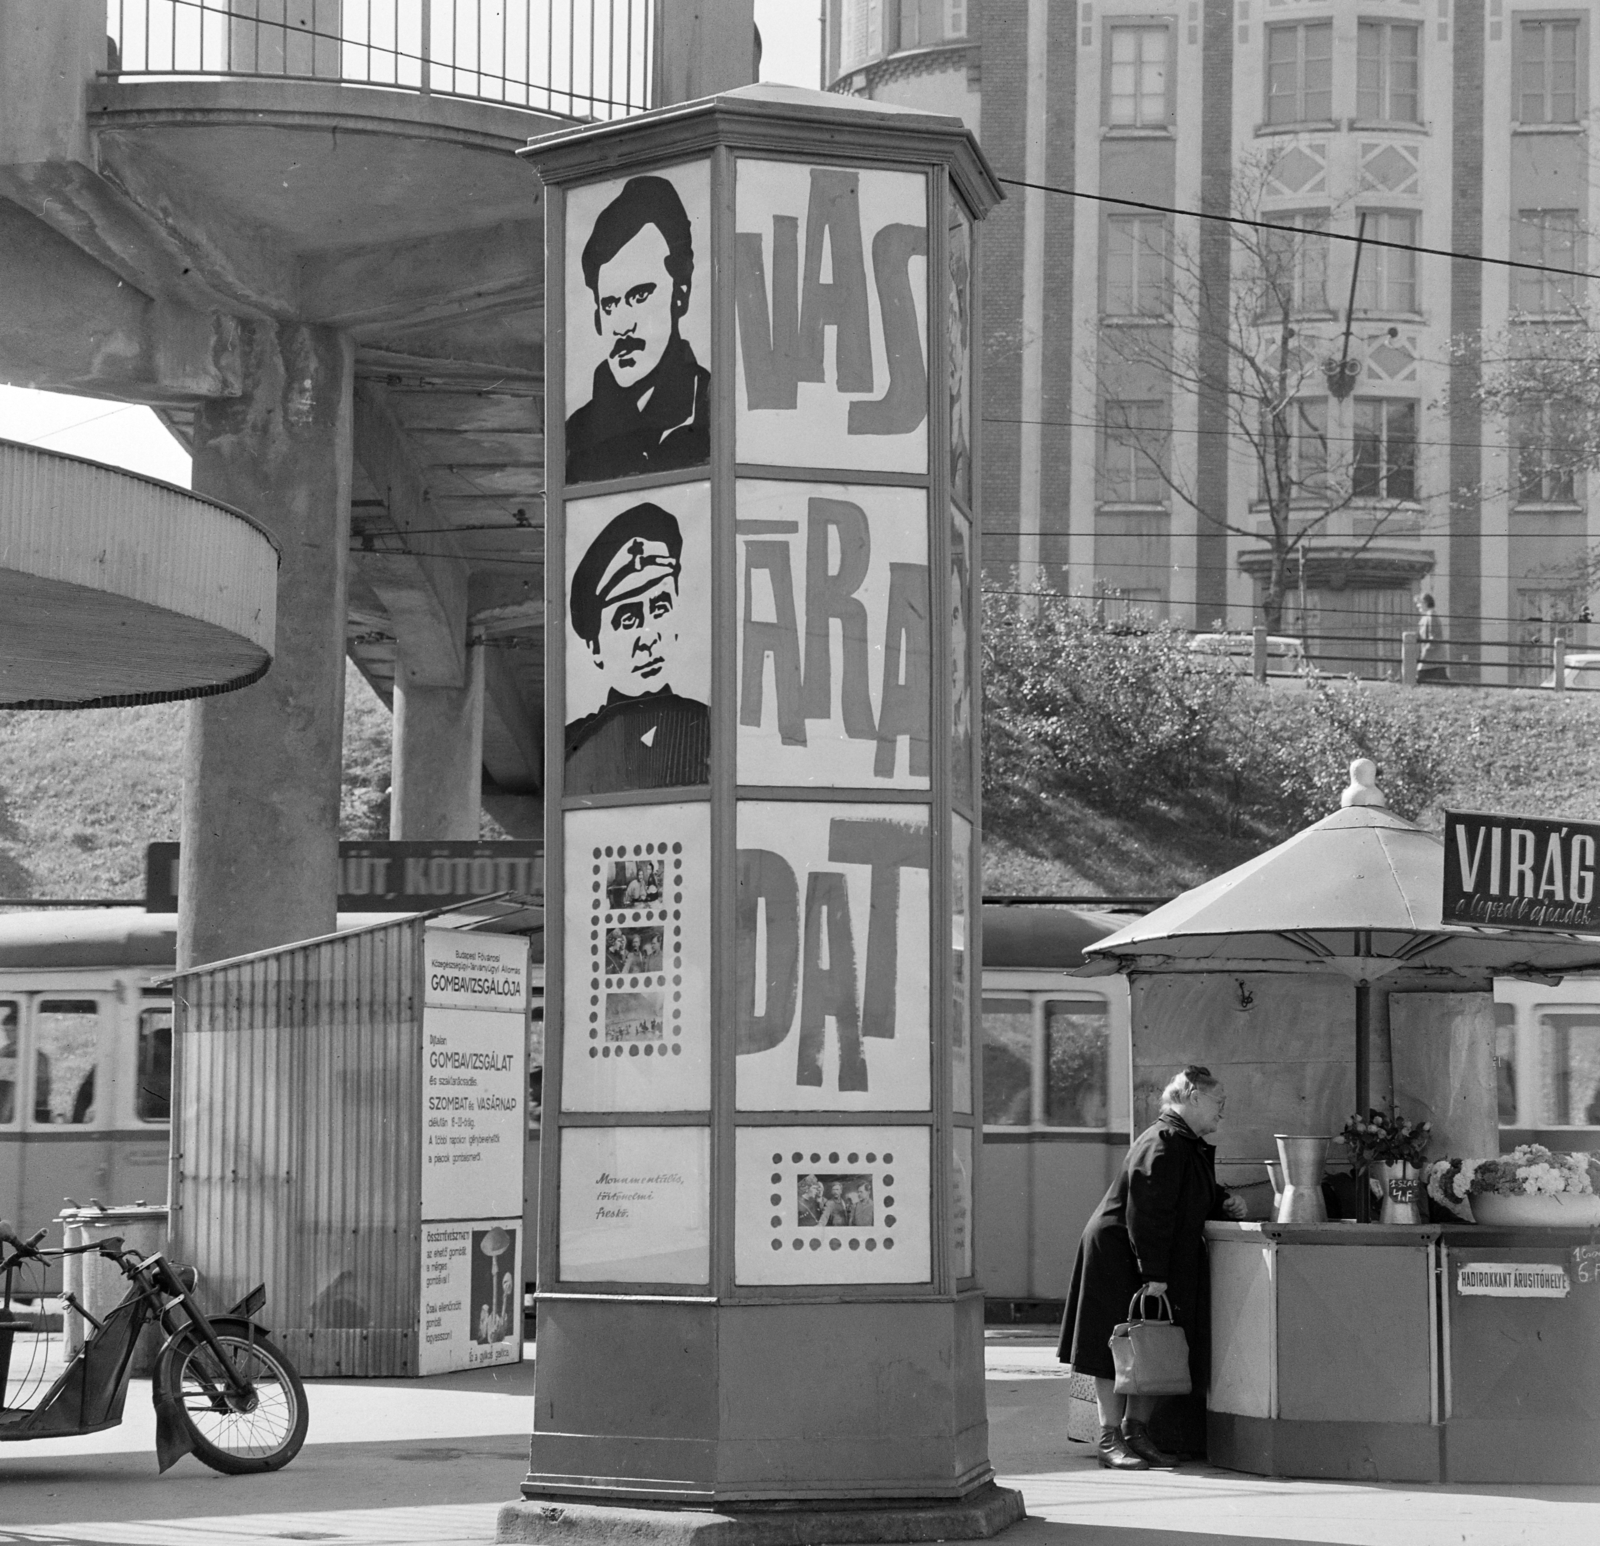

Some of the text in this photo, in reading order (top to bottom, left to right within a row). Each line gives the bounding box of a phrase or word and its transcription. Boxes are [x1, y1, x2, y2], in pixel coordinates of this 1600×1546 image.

[735, 167, 927, 436] VAS
[1454, 822, 1596, 904] VIRÁG
[735, 817, 930, 1092] DAT
[431, 974, 521, 996] GOMBAVIZSGÁLÓJA
[429, 1050, 514, 1072] GOMBAVIZSGÁLAT
[428, 1096, 468, 1111] SZOMBAT
[476, 1094, 517, 1112] VASÁRNAP
[1461, 1268, 1567, 1289] HADIROKKANT ÁRUSITÓHELYE
